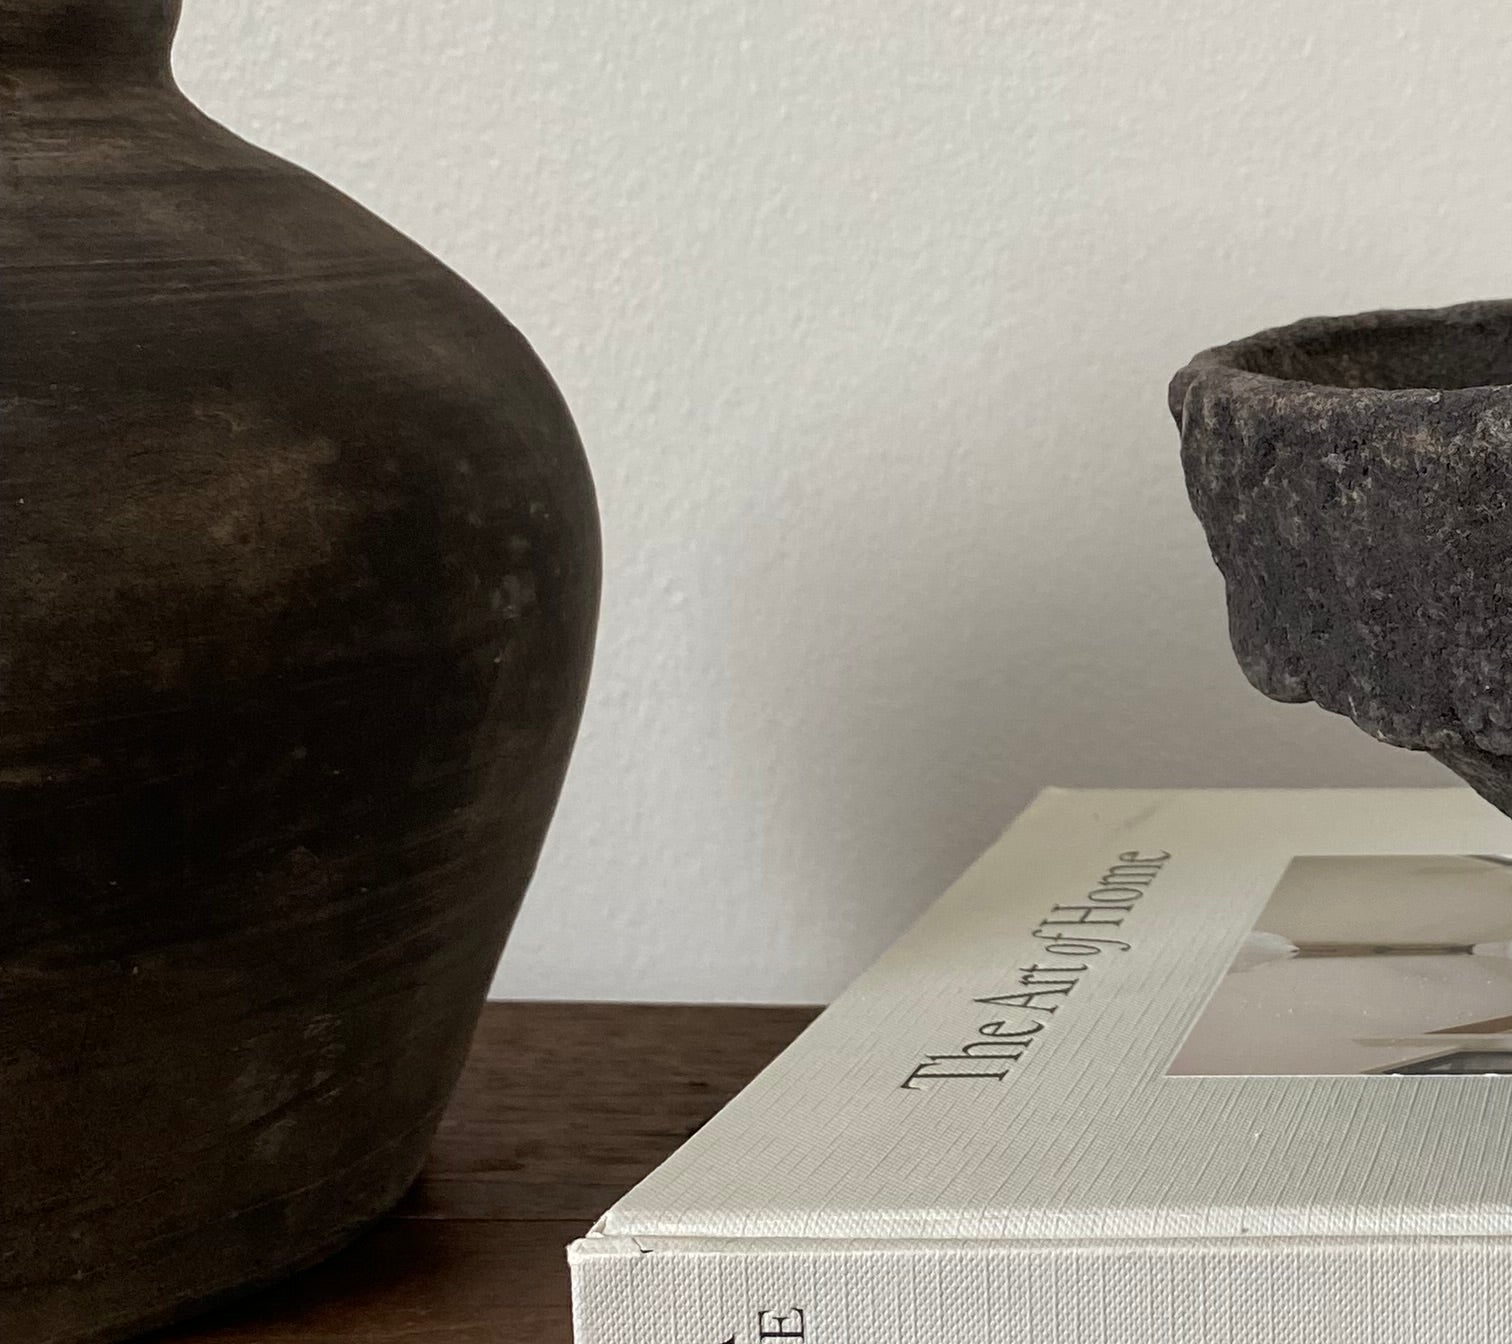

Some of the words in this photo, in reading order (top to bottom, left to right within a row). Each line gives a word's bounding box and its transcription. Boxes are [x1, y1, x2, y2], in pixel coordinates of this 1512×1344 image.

[1038, 850, 1172, 927] Home
[1032, 928, 1131, 956] of
[973, 963, 1088, 1014] Art
[900, 1019, 1045, 1090] The
